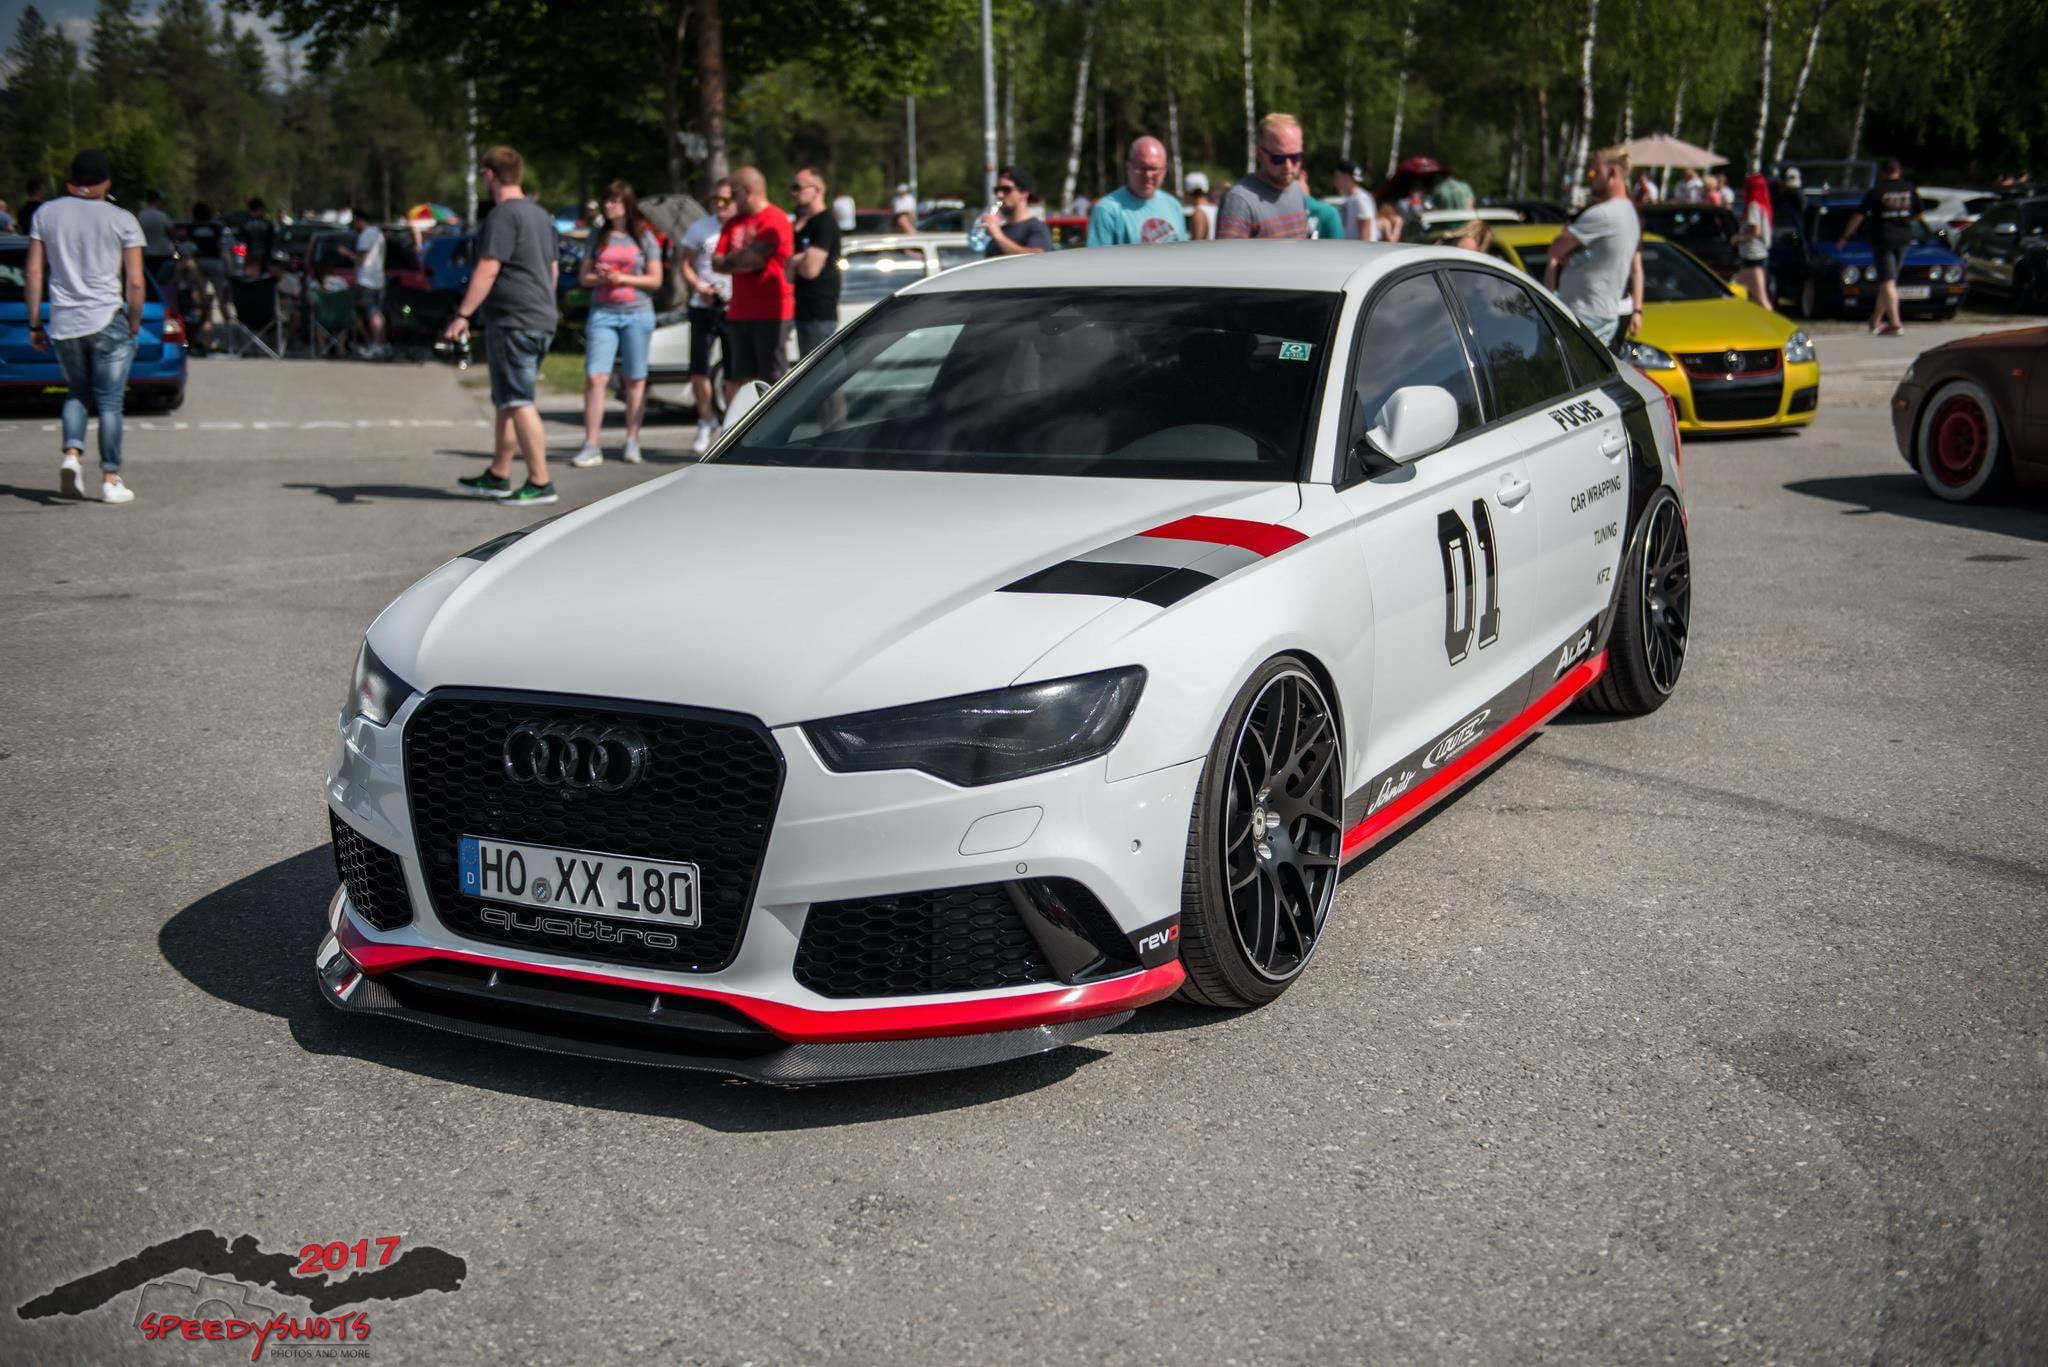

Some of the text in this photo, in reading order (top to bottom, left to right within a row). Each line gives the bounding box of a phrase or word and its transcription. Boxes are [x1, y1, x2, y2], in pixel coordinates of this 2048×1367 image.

[1548, 399, 1604, 432] FUCHS
[1570, 475, 1621, 513] CAR WRAPPING
[1594, 521, 1617, 546] TUNING
[1437, 497, 1501, 667] 01
[1597, 566, 1611, 585] KFZ
[481, 846, 694, 918] HO XX 180
[480, 907, 678, 950] quattro
